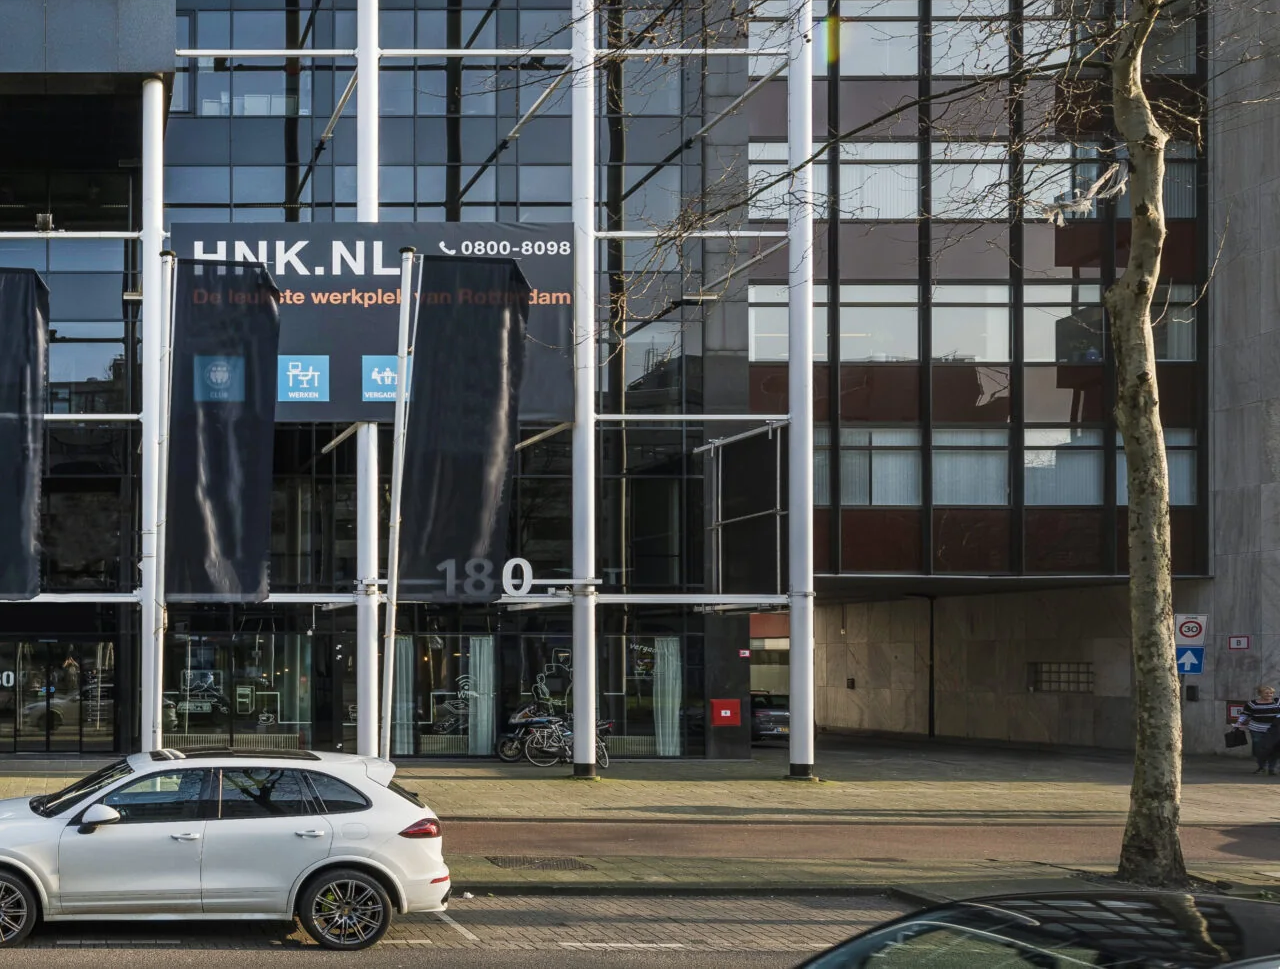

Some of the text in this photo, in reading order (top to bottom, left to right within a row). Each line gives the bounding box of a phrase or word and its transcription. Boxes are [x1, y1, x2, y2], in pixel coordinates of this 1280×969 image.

[461, 240, 571, 256] 0800-8098
[193, 239, 401, 276] HNK.NL
[287, 391, 319, 399] WERKEN
[435, 557, 533, 597] 180
[1183, 625, 1199, 633] 30
